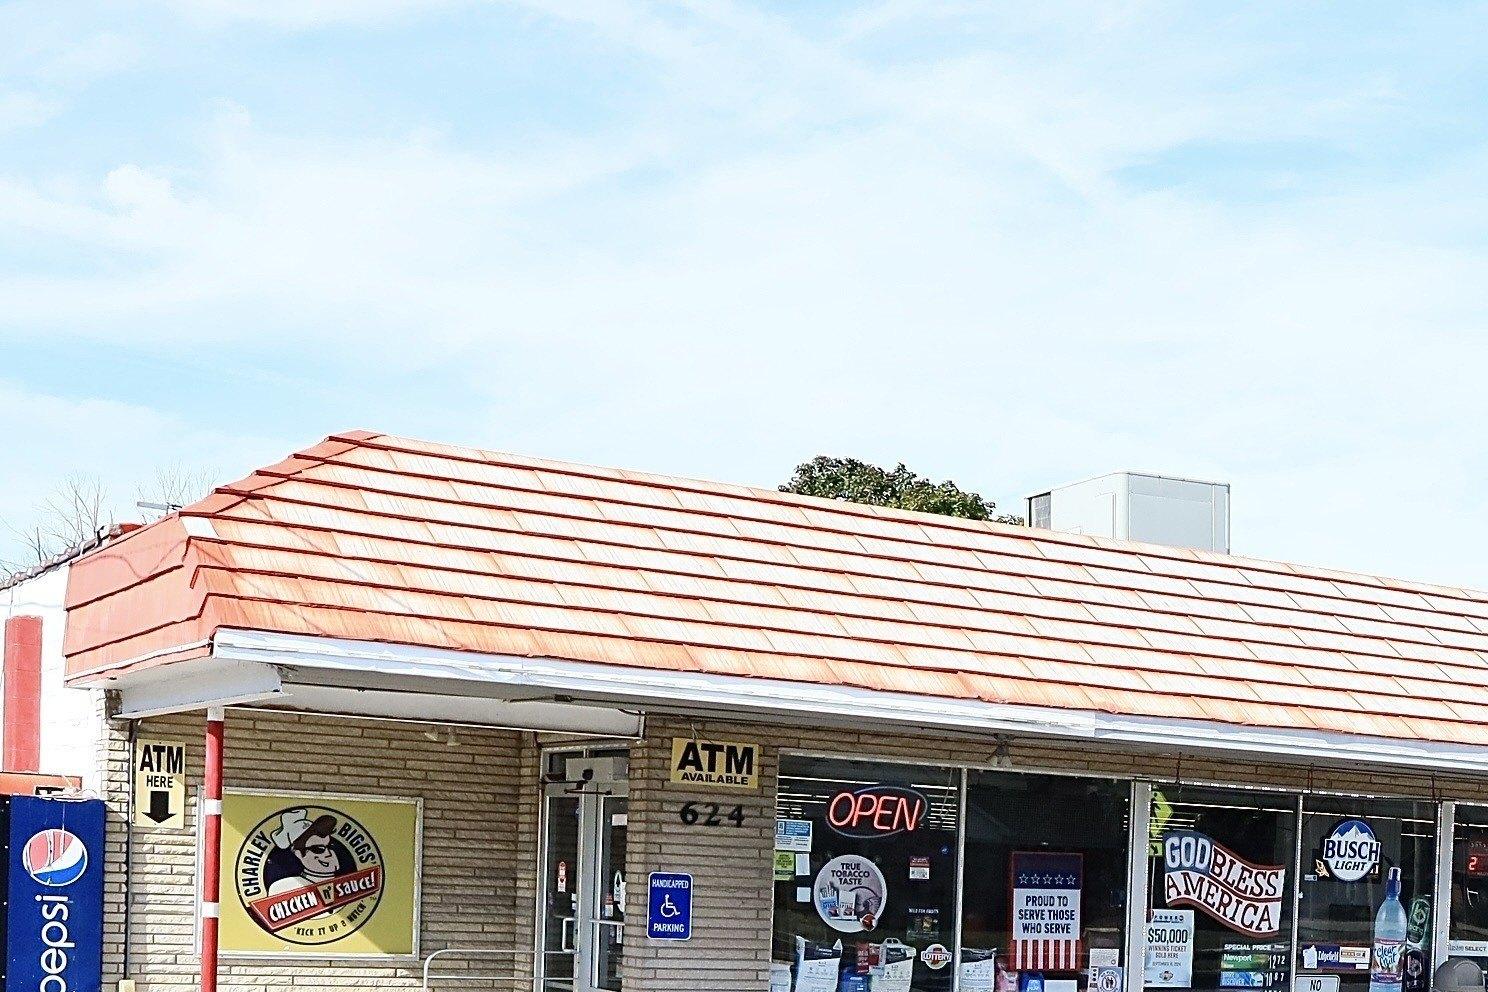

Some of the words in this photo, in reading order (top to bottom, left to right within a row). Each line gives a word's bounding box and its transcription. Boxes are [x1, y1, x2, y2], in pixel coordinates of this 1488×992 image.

[139, 743, 184, 775] ATM
[677, 742, 754, 776] ATM
[146, 776, 173, 788] HERE
[681, 772, 748, 786] AVAILABLE
[680, 801, 745, 828] 624
[828, 791, 921, 832] OPEN
[1325, 840, 1380, 863] BUSCH
[244, 831, 272, 897] CHARLEY
[338, 822, 377, 865] BIGGS'
[841, 862, 861, 870] TRUE
[1468, 856, 1478, 870] 2
[1165, 836, 1211, 870] GOD
[1210, 847, 1279, 897] BLESS
[1334, 861, 1368, 872] LIGHT
[831, 870, 870, 878] TOBACCO
[652, 879, 689, 889] HANDICAPPED
[269, 891, 318, 922] CHICKEN
[1025, 895, 1055, 907] PROUD
[1057, 895, 1068, 906] TO
[1166, 872, 1274, 932] AMERICA
[1018, 909, 1045, 920] SERVE
[1047, 909, 1075, 921] THOSE
[653, 923, 685, 933] PARKING
[1022, 923, 1042, 934] WHO
[1044, 923, 1071, 934] SERVE
[1147, 927, 1188, 945] $50,000
[922, 952, 952, 961] LOTTERY
[1223, 953, 1252, 962] Newport
[1309, 979, 1322, 991] NO
